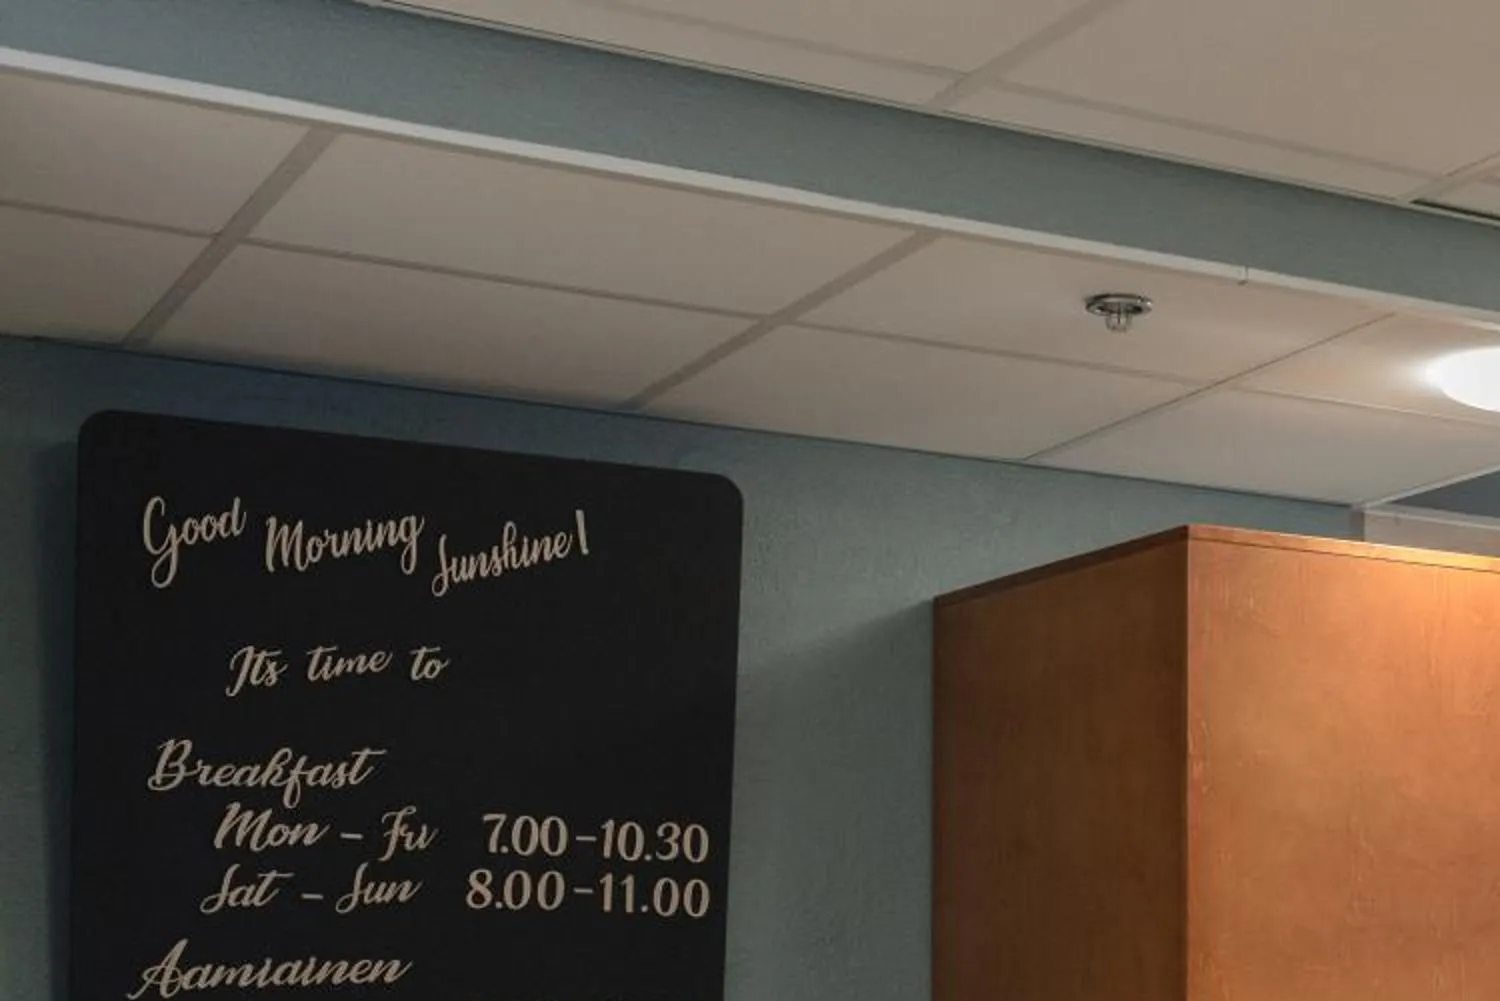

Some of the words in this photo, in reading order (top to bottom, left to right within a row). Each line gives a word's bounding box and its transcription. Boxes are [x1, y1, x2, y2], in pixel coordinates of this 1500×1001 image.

[142, 495, 247, 589] Good
[264, 513, 426, 577] Morning
[430, 508, 591, 598] Sunshine!
[224, 644, 289, 697] Its
[305, 643, 394, 683] time
[409, 643, 450, 682] to
[146, 737, 388, 809] Breakfast
[212, 799, 331, 853] Mon
[378, 803, 439, 863] Fri
[199, 862, 295, 914] Sat
[334, 861, 423, 914] Sun
[125, 937, 414, 1001] Aamiainen
